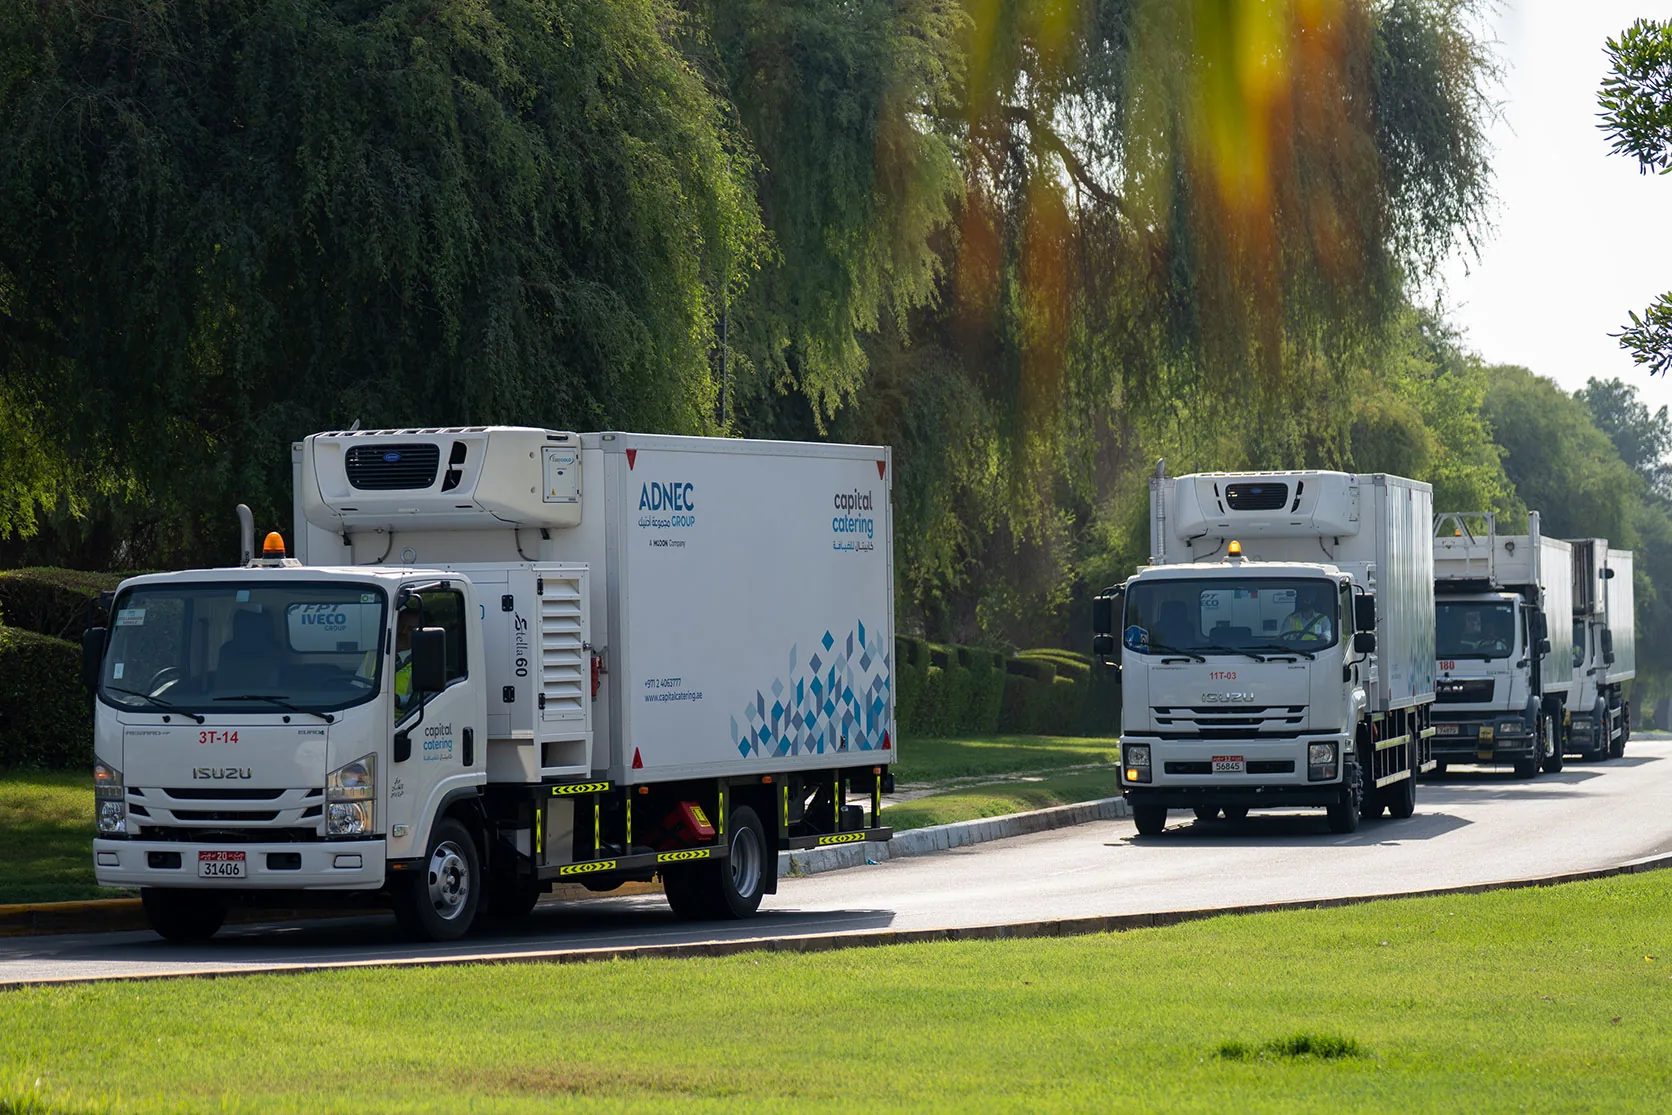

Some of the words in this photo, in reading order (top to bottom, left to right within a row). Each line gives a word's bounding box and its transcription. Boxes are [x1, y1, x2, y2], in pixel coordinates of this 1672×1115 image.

[638, 481, 695, 512] ADNEC
[834, 488, 873, 515] capital
[671, 515, 696, 527] GROUP
[832, 513, 874, 539] catering
[302, 604, 339, 613] FPT
[301, 613, 347, 625] IVECO
[515, 657, 528, 677] 60
[1439, 660, 1455, 670] 180
[1209, 672, 1237, 680] 11T-03
[644, 691, 703, 702] www.capitalcatering.ae
[1201, 693, 1255, 703] ISUZU
[424, 722, 453, 739] capital
[199, 731, 239, 744] 3T-14
[423, 737, 453, 752] catering
[1215, 762, 1241, 770] 56845
[192, 767, 252, 780] ISUZU
[216, 851, 228, 861] 20
[204, 862, 240, 876] 31406
